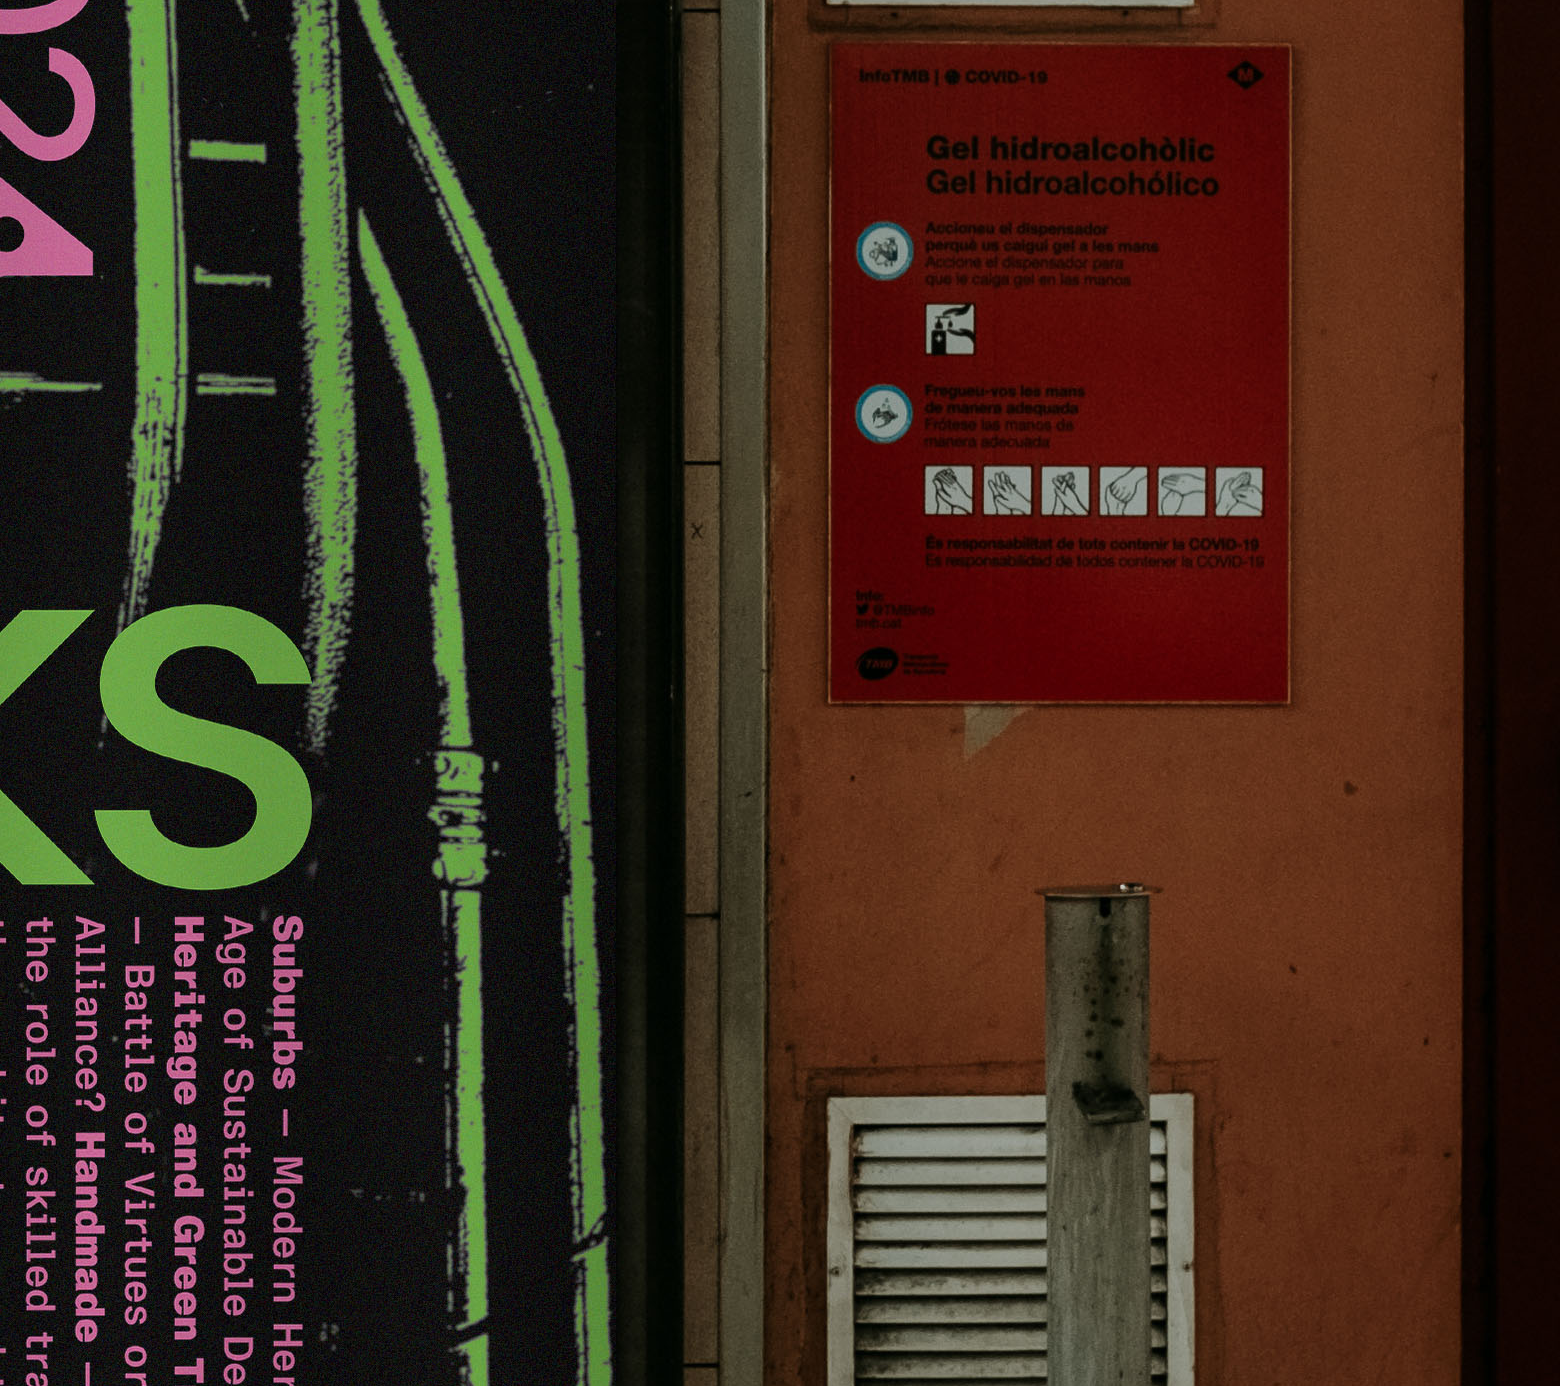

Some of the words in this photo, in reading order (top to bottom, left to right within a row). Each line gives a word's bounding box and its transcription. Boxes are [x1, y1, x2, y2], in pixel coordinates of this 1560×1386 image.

[858, 68, 931, 83] InfoTMB
[965, 70, 1049, 84] COVID-19
[925, 134, 979, 161] Gel
[990, 135, 1216, 163] hidroalcohòlic
[925, 169, 977, 195] Gel
[985, 169, 1220, 197] hidroalcohólico
[925, 221, 995, 236] Accioneu
[999, 221, 1013, 236] el
[1016, 221, 1109, 238] dispensador
[924, 384, 1017, 400] Fregueu-vos
[1019, 384, 1041, 398] les
[1045, 387, 1086, 398] mans
[924, 402, 943, 414] de
[946, 403, 1002, 414] manera
[1006, 402, 1079, 416] adequada
[26, 918, 58, 982] the
[216, 917, 255, 989] Age
[75, 917, 107, 1112] Alliance?
[125, 966, 157, 1093] Battle
[167, 918, 207, 1106] Heritage
[224, 1010, 255, 1050] of
[273, 917, 305, 1090] Suburbs
[26, 1006, 58, 1086] role
[26, 1107, 58, 1147] of
[125, 1114, 157, 1154] of
[174, 1124, 206, 1198] and
[223, 1070, 256, 1317] Sustainable
[273, 1158, 305, 1303] Modern
[26, 1169, 58, 1312] skilled
[75, 1134, 107, 1343] Handmade
[125, 1174, 157, 1326] Virtues
[174, 1217, 207, 1341] Green
